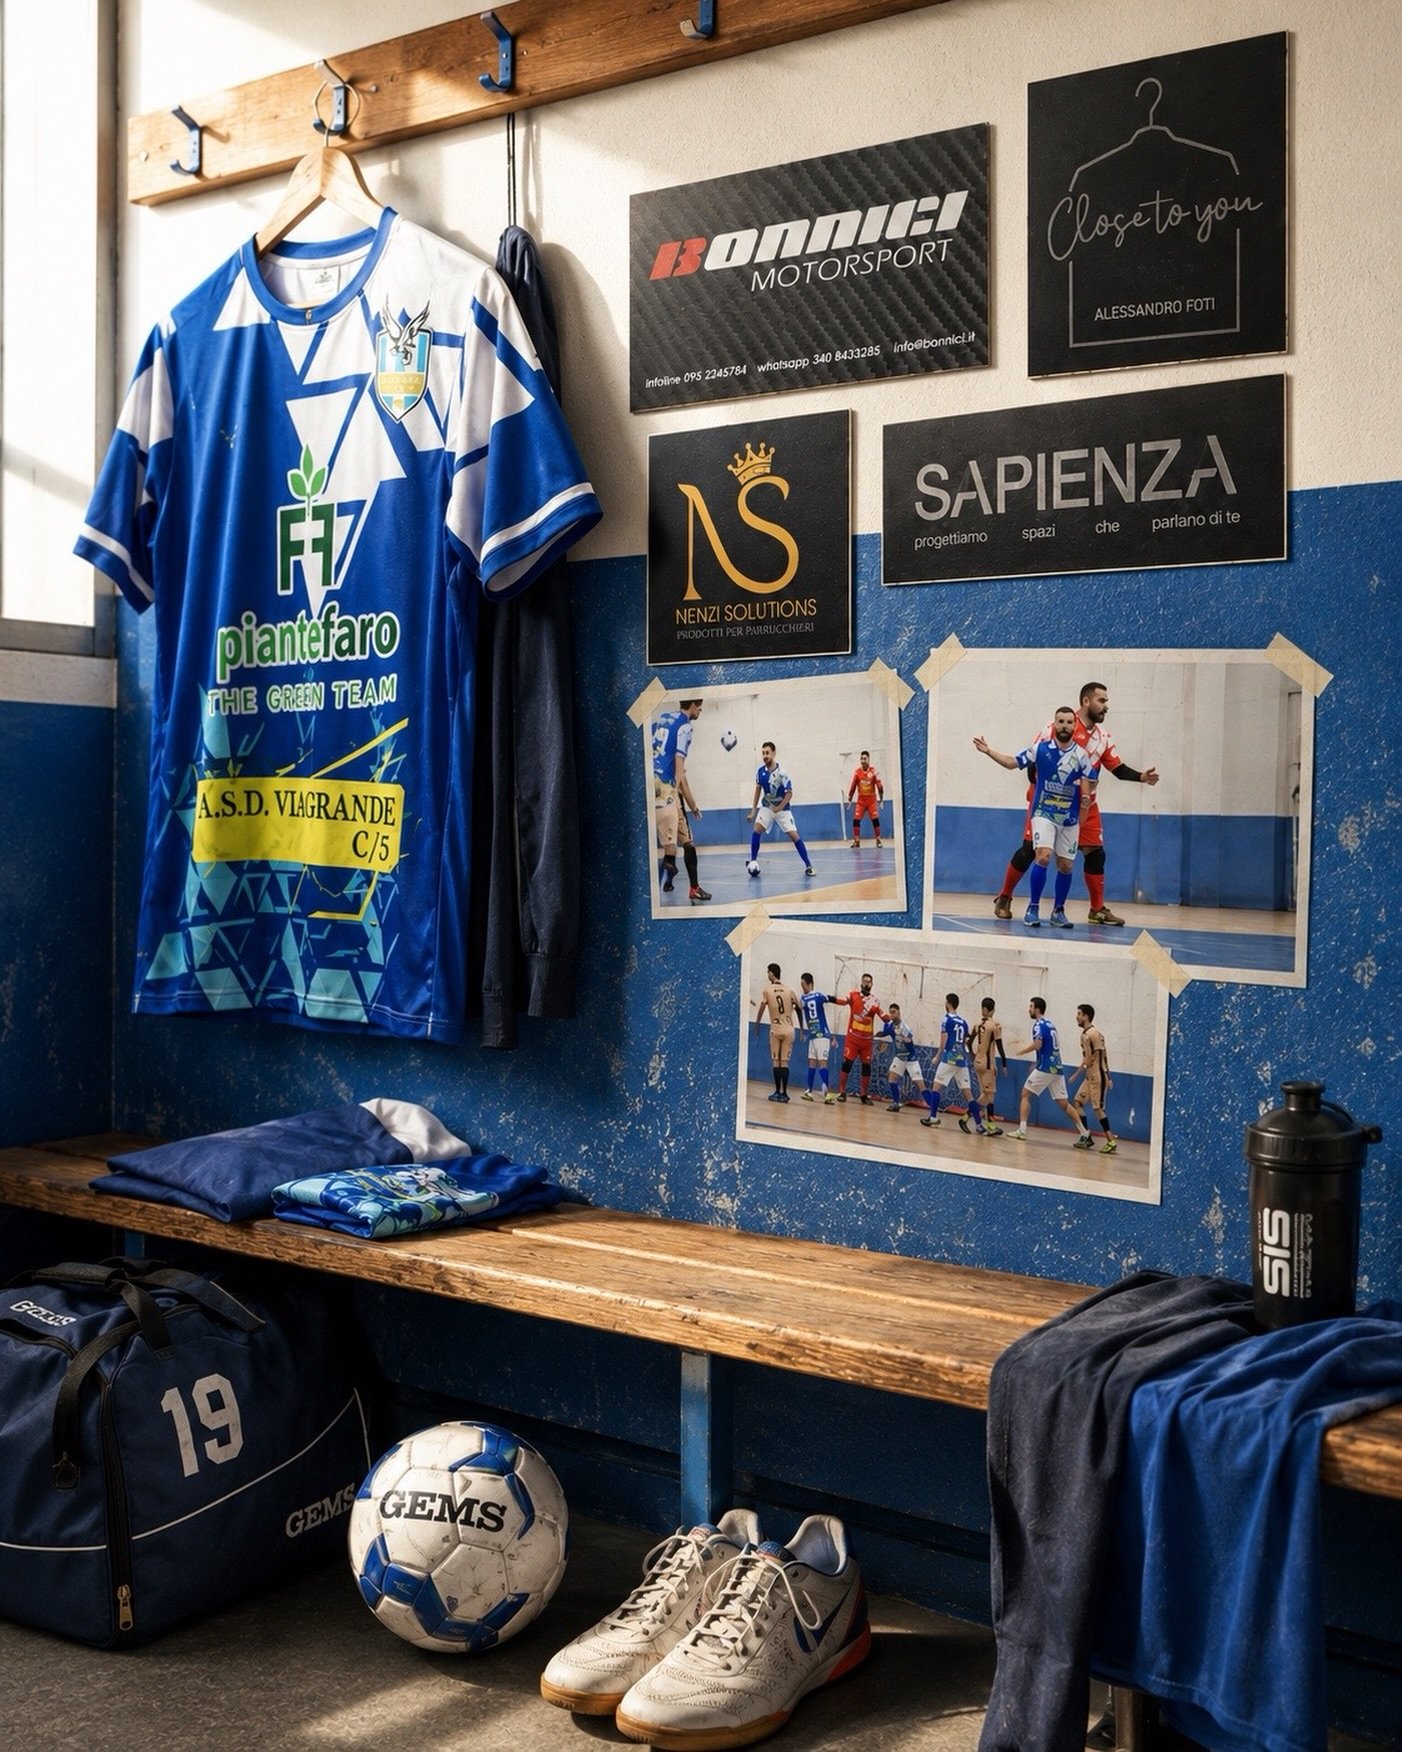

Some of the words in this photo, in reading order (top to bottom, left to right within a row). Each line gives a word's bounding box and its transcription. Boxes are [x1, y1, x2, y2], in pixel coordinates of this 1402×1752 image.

[1194, 196, 1264, 243] you
[751, 238, 953, 292] MOTORSPORT
[1094, 300, 1182, 321] ALESSANDRO
[1186, 297, 1216, 312] FOTI
[645, 375, 681, 388] infoline
[683, 371, 702, 383] 095
[756, 356, 809, 374] whatsapp
[812, 352, 832, 365] 340
[914, 434, 1238, 521] SAPIENZA
[914, 529, 988, 551] progettiamo
[1021, 523, 1056, 542] spazi
[1095, 519, 1120, 535] che
[1151, 513, 1206, 533] parlano
[1209, 510, 1223, 526] di
[1226, 509, 1241, 524] te
[675, 605, 720, 625] NENZI
[724, 598, 817, 622] SOLUTIONS
[216, 601, 401, 684] piantefaro
[676, 628, 723, 640] PRODOTTI
[726, 627, 744, 637] PER
[207, 687, 258, 717] THE
[267, 681, 324, 713] GREEN
[332, 673, 397, 709] TEAM
[198, 789, 269, 819] A.S.D.
[274, 790, 396, 826] VIAGRANDE
[351, 830, 390, 864] C/5
[160, 1373, 244, 1478] 19
[285, 1482, 355, 1538] GEMS
[380, 1490, 507, 1532] GEMS
